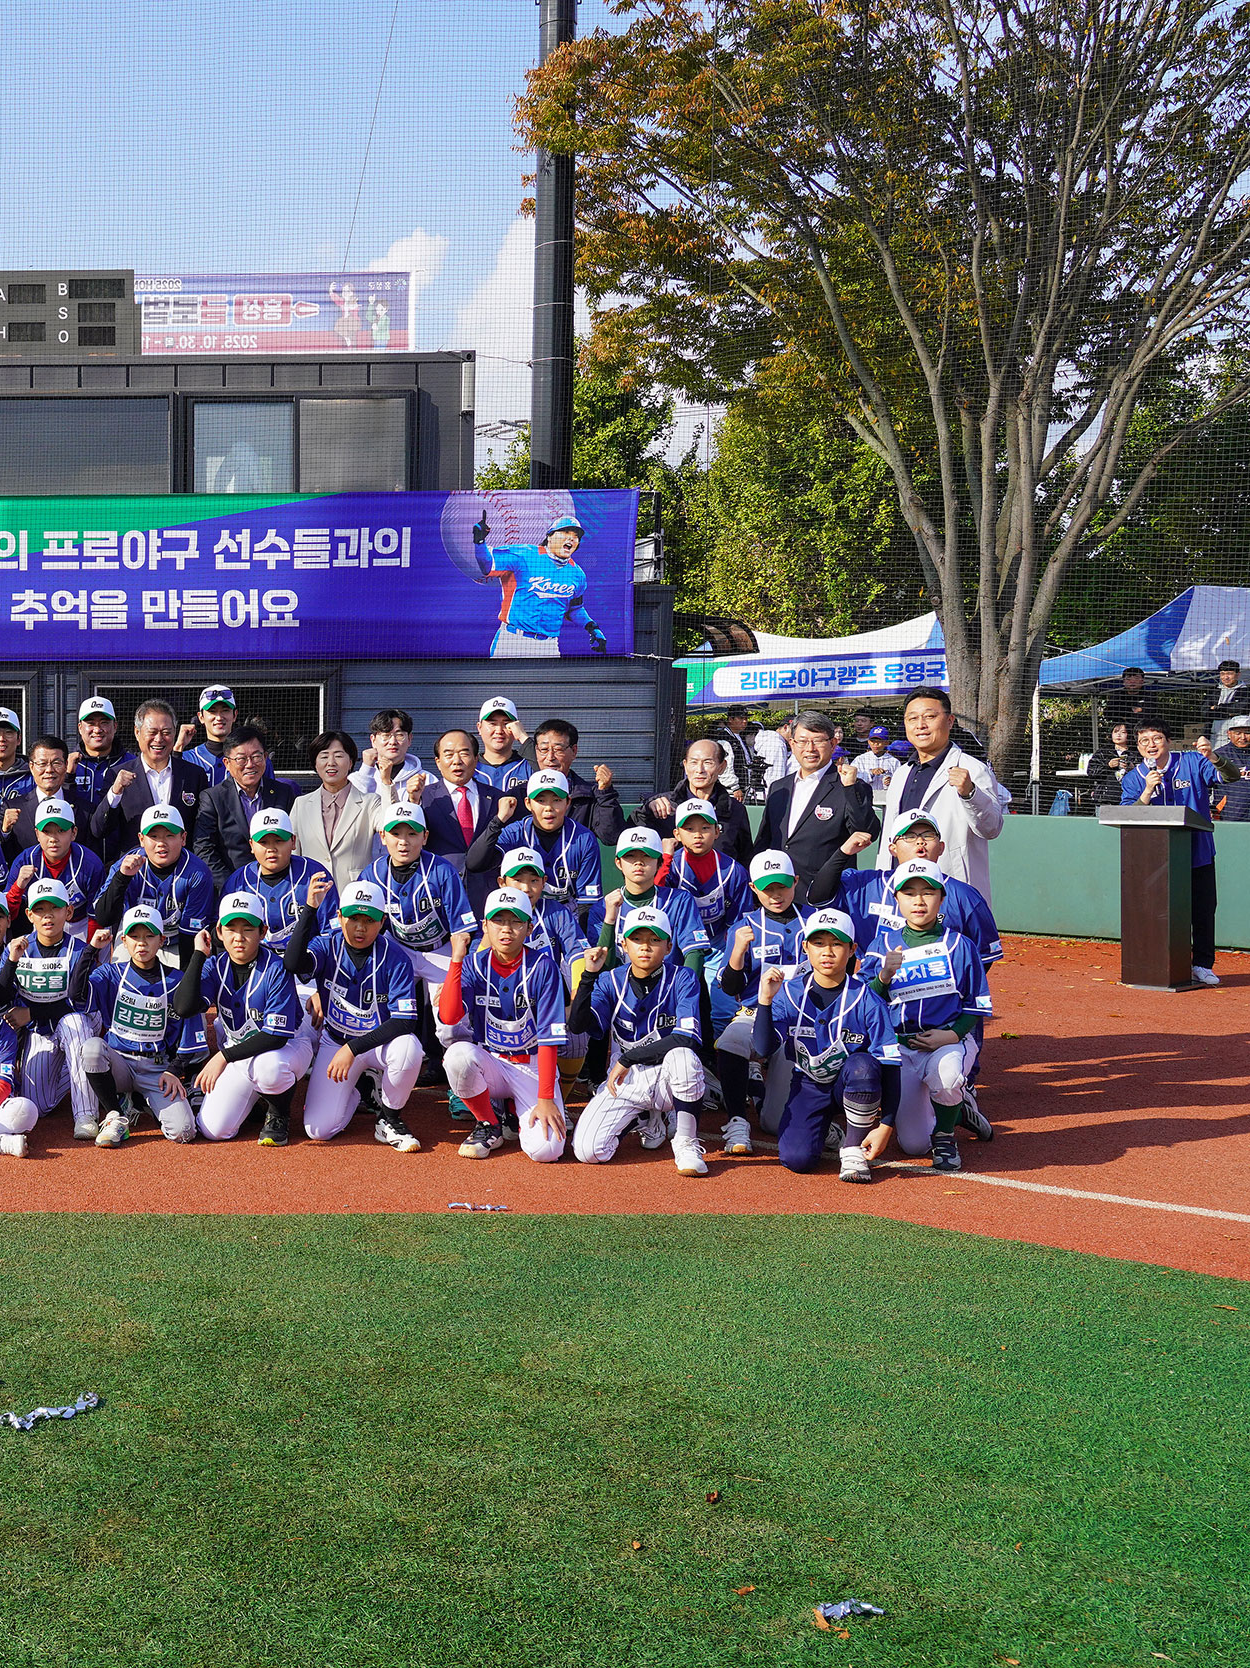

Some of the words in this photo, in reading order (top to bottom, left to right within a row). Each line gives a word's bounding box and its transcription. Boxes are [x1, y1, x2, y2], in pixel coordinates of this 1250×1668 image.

[58, 283, 67, 296] B
[58, 307, 68, 319] S
[58, 331, 69, 343] O
[42, 529, 199, 571] 프로야구
[213, 527, 410, 569] 선수들과의
[528, 576, 575, 597] Korea
[10, 589, 128, 630] 추억을
[142, 588, 299, 629] 만들어요
[740, 664, 877, 691] 김태균야구캠프
[884, 661, 946, 683] 운영국
